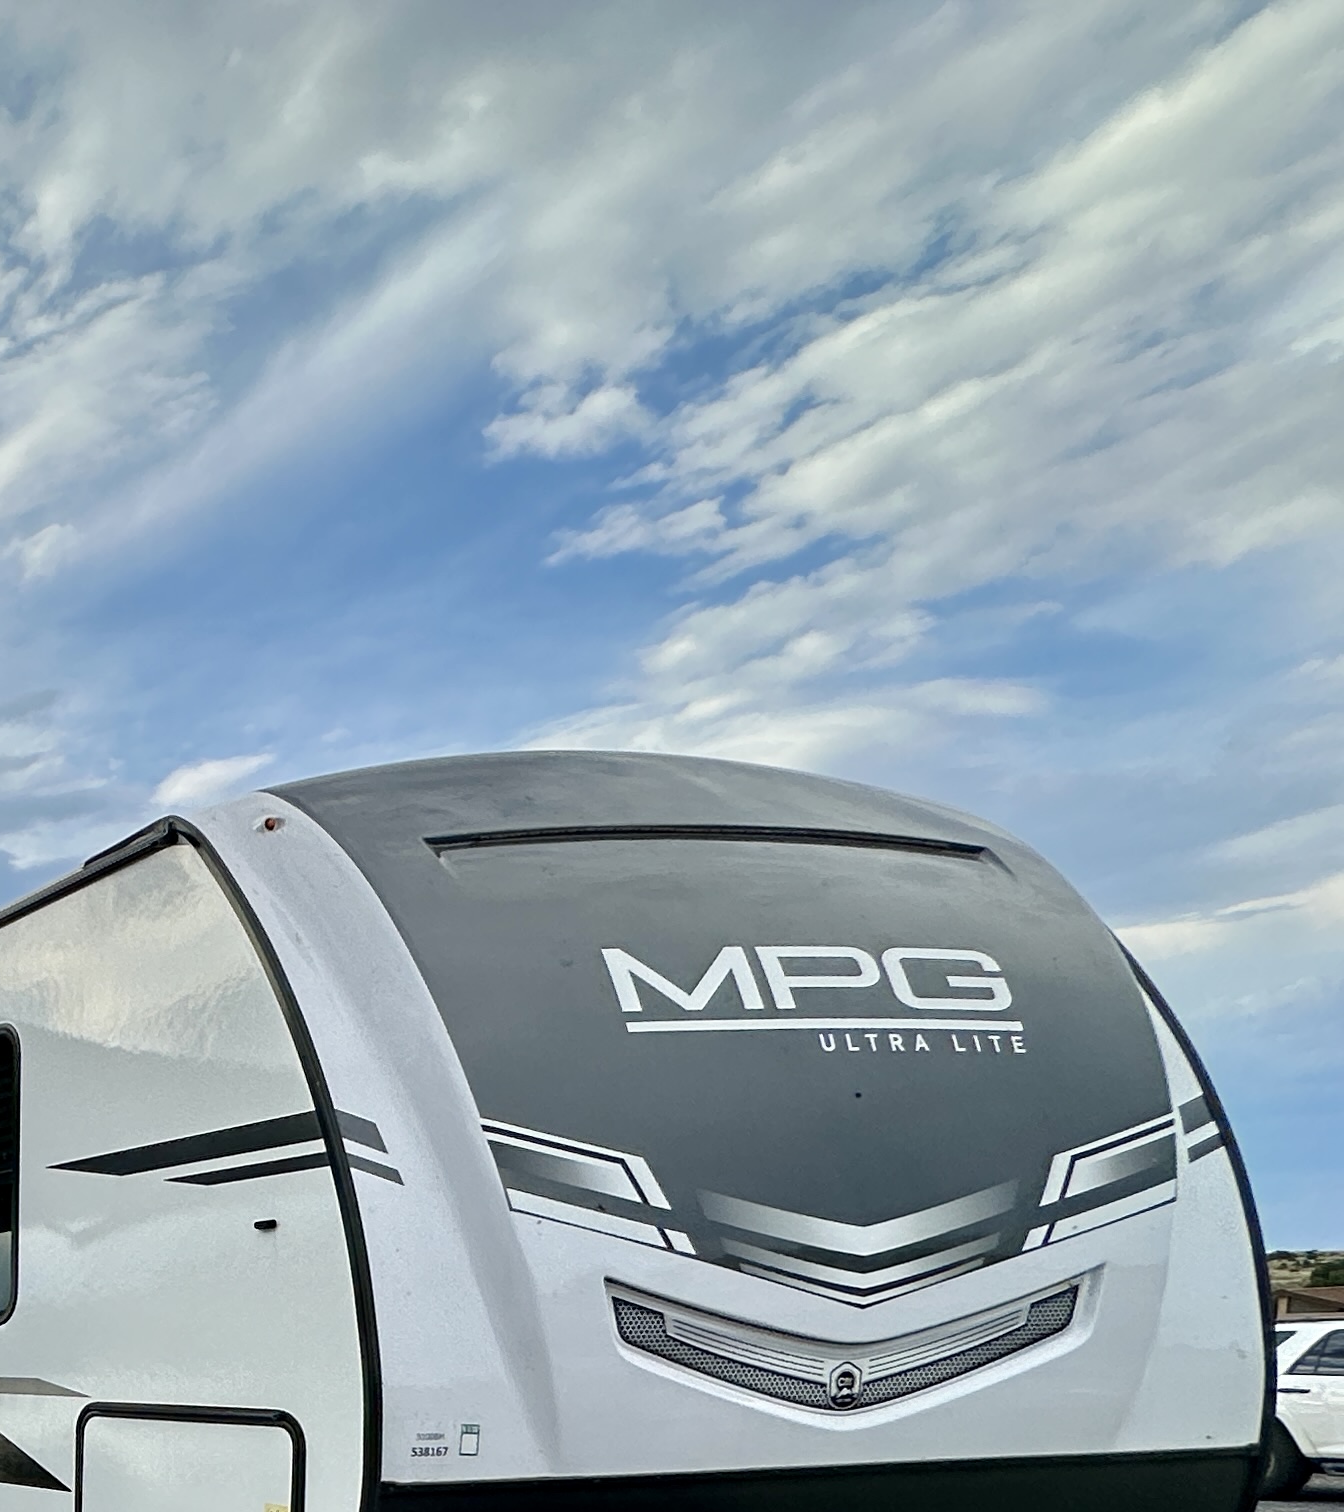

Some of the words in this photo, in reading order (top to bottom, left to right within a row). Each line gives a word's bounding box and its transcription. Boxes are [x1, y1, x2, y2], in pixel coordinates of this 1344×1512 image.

[601, 946, 1012, 1012] MPG
[819, 1033, 930, 1052] ULTRA
[951, 1034, 1027, 1054] LITE
[411, 1446, 449, 1457] 538167
